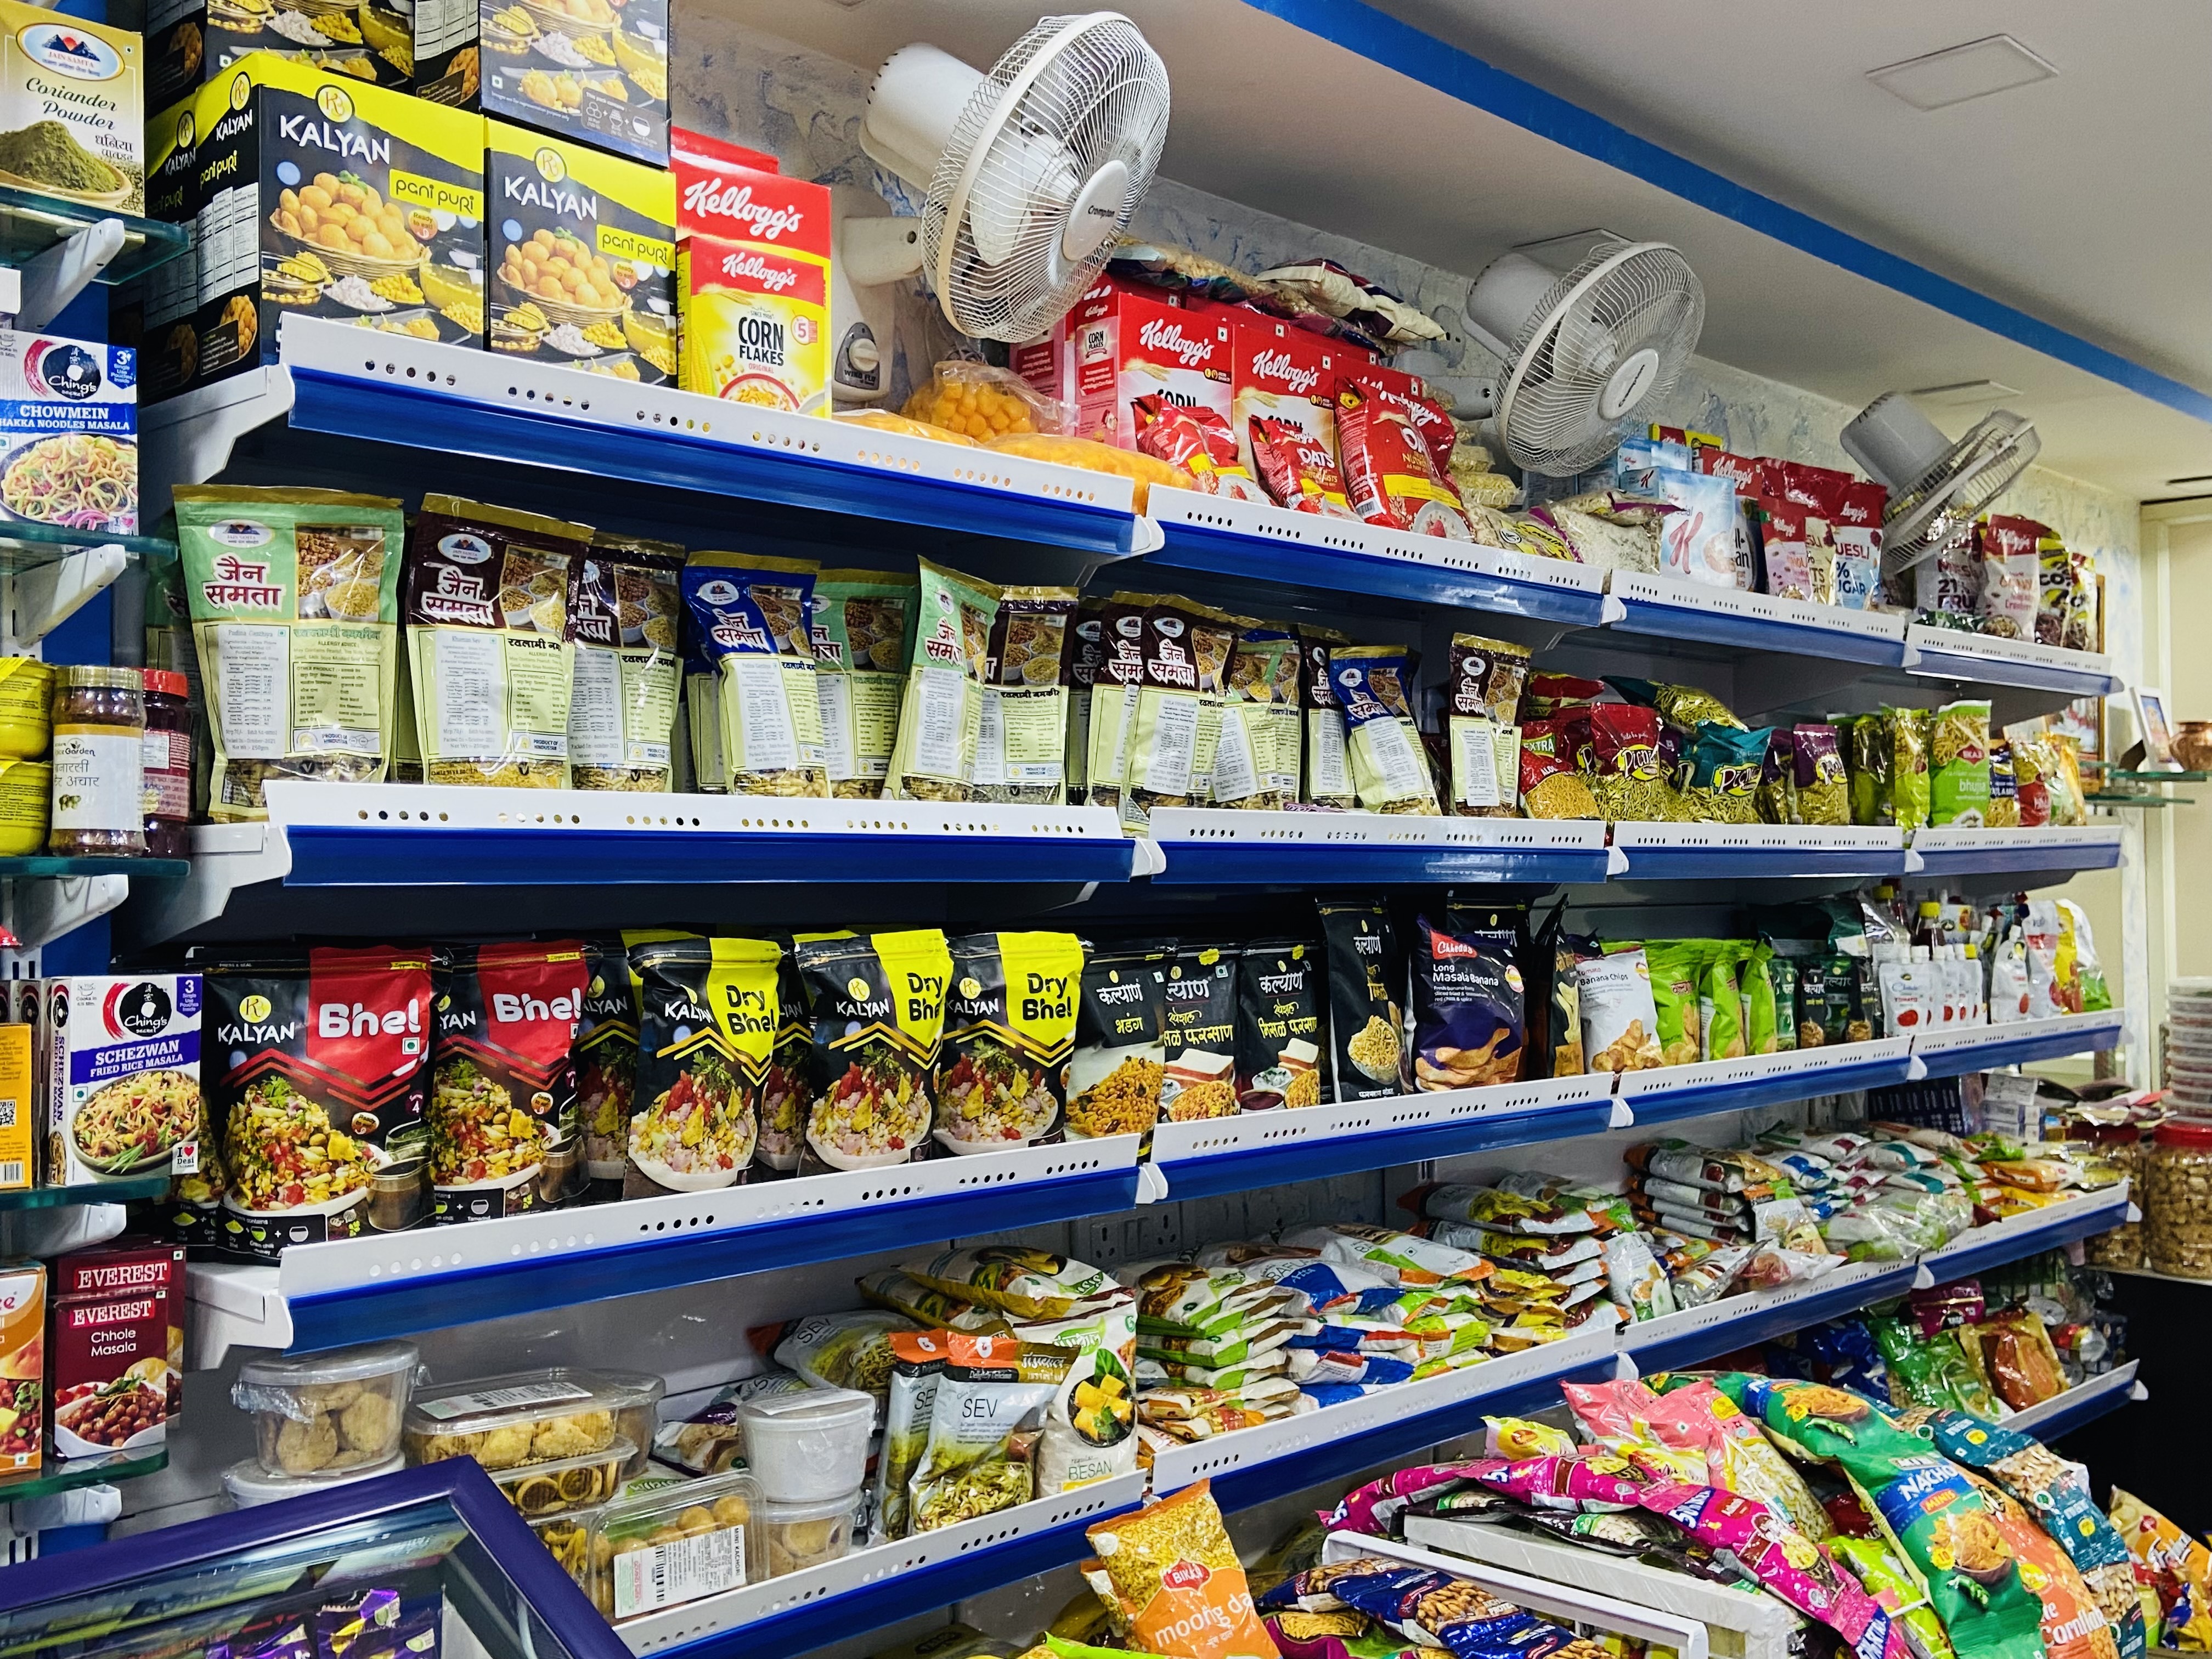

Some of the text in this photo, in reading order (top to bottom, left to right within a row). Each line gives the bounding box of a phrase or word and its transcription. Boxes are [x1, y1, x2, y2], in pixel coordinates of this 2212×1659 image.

[26, 77, 117, 111] Coriander
[43, 100, 114, 130] Powder
[216, 109, 253, 142] KALYAN
[95, 133, 133, 153] धनिया
[280, 115, 390, 165] KALYAN
[165, 147, 196, 176] KALYAN
[396, 179, 433, 201] pani
[505, 176, 597, 221] KALYAN
[413, 212, 433, 224] Ready
[684, 178, 804, 240] Kellogg's
[1088, 205, 1115, 219] Crompton
[602, 234, 634, 253] pani
[722, 252, 798, 292] Kellogg's
[738, 317, 784, 352] CORN
[798, 323, 806, 338] 5
[1088, 330, 1104, 345] CORN
[1139, 318, 1215, 366] Kellogg's
[116, 351, 127, 365] 3
[740, 345, 784, 366] FLAKES
[748, 363, 774, 374] ORIGINAL
[1252, 348, 1319, 393] Kellogg's
[48, 376, 97, 394] Ching's
[20, 405, 109, 420] CHOWMEIN
[37, 420, 85, 430] NOODLES
[88, 420, 130, 431] MASALA
[1297, 447, 1335, 469] OATS
[1669, 511, 1703, 575] K
[217, 556, 266, 583] जैन
[205, 585, 281, 606] समता
[442, 571, 481, 599] जैन
[507, 638, 545, 649] रतलामी
[714, 629, 764, 648] समता
[1161, 642, 1184, 663] जैन
[65, 747, 95, 758] Garden
[1525, 738, 1554, 753] EXTRA
[66, 776, 99, 787] अचार
[1959, 777, 1987, 794] bhujia
[1433, 972, 1499, 986] Masala Banana
[1434, 964, 1454, 972] Long
[184, 980, 194, 994] 3
[907, 973, 943, 998] Dry
[1028, 973, 1068, 998] Dry
[1259, 972, 1303, 994] कल्याण
[1580, 975, 1609, 986] Banana
[493, 987, 582, 1023] Bhel
[726, 985, 765, 1010] Dry
[1097, 983, 1143, 1005] कल्याण
[319, 998, 421, 1038] Bhel
[665, 1001, 714, 1023] KALYAN
[836, 998, 890, 1018] KALYAN
[946, 998, 999, 1016] KALYAN
[1022, 996, 1072, 1021] Bhel
[124, 1015, 167, 1029] Ching's
[727, 1008, 775, 1035] Bhel
[1116, 1013, 1143, 1034] भडंग
[1259, 1017, 1286, 1039] मिसळ
[218, 1022, 295, 1045] KALYAN
[1186, 1025, 1233, 1045] फरसाण
[95, 1040, 180, 1066] SCHEZWAN
[90, 1053, 183, 1077] FRIED RICE MASALA
[77, 1262, 167, 1289] EVEREST
[73, 1300, 151, 1326] EVEREST
[91, 1328, 136, 1344] Chhole
[91, 1341, 137, 1357] Masala
[962, 1398, 998, 1419] SEV
[1068, 1459, 1113, 1481] BESAN
[1898, 1465, 1959, 1502] NACHO
[1926, 1490, 1956, 1511] MINIS
[1155, 1607, 1231, 1647] moong
